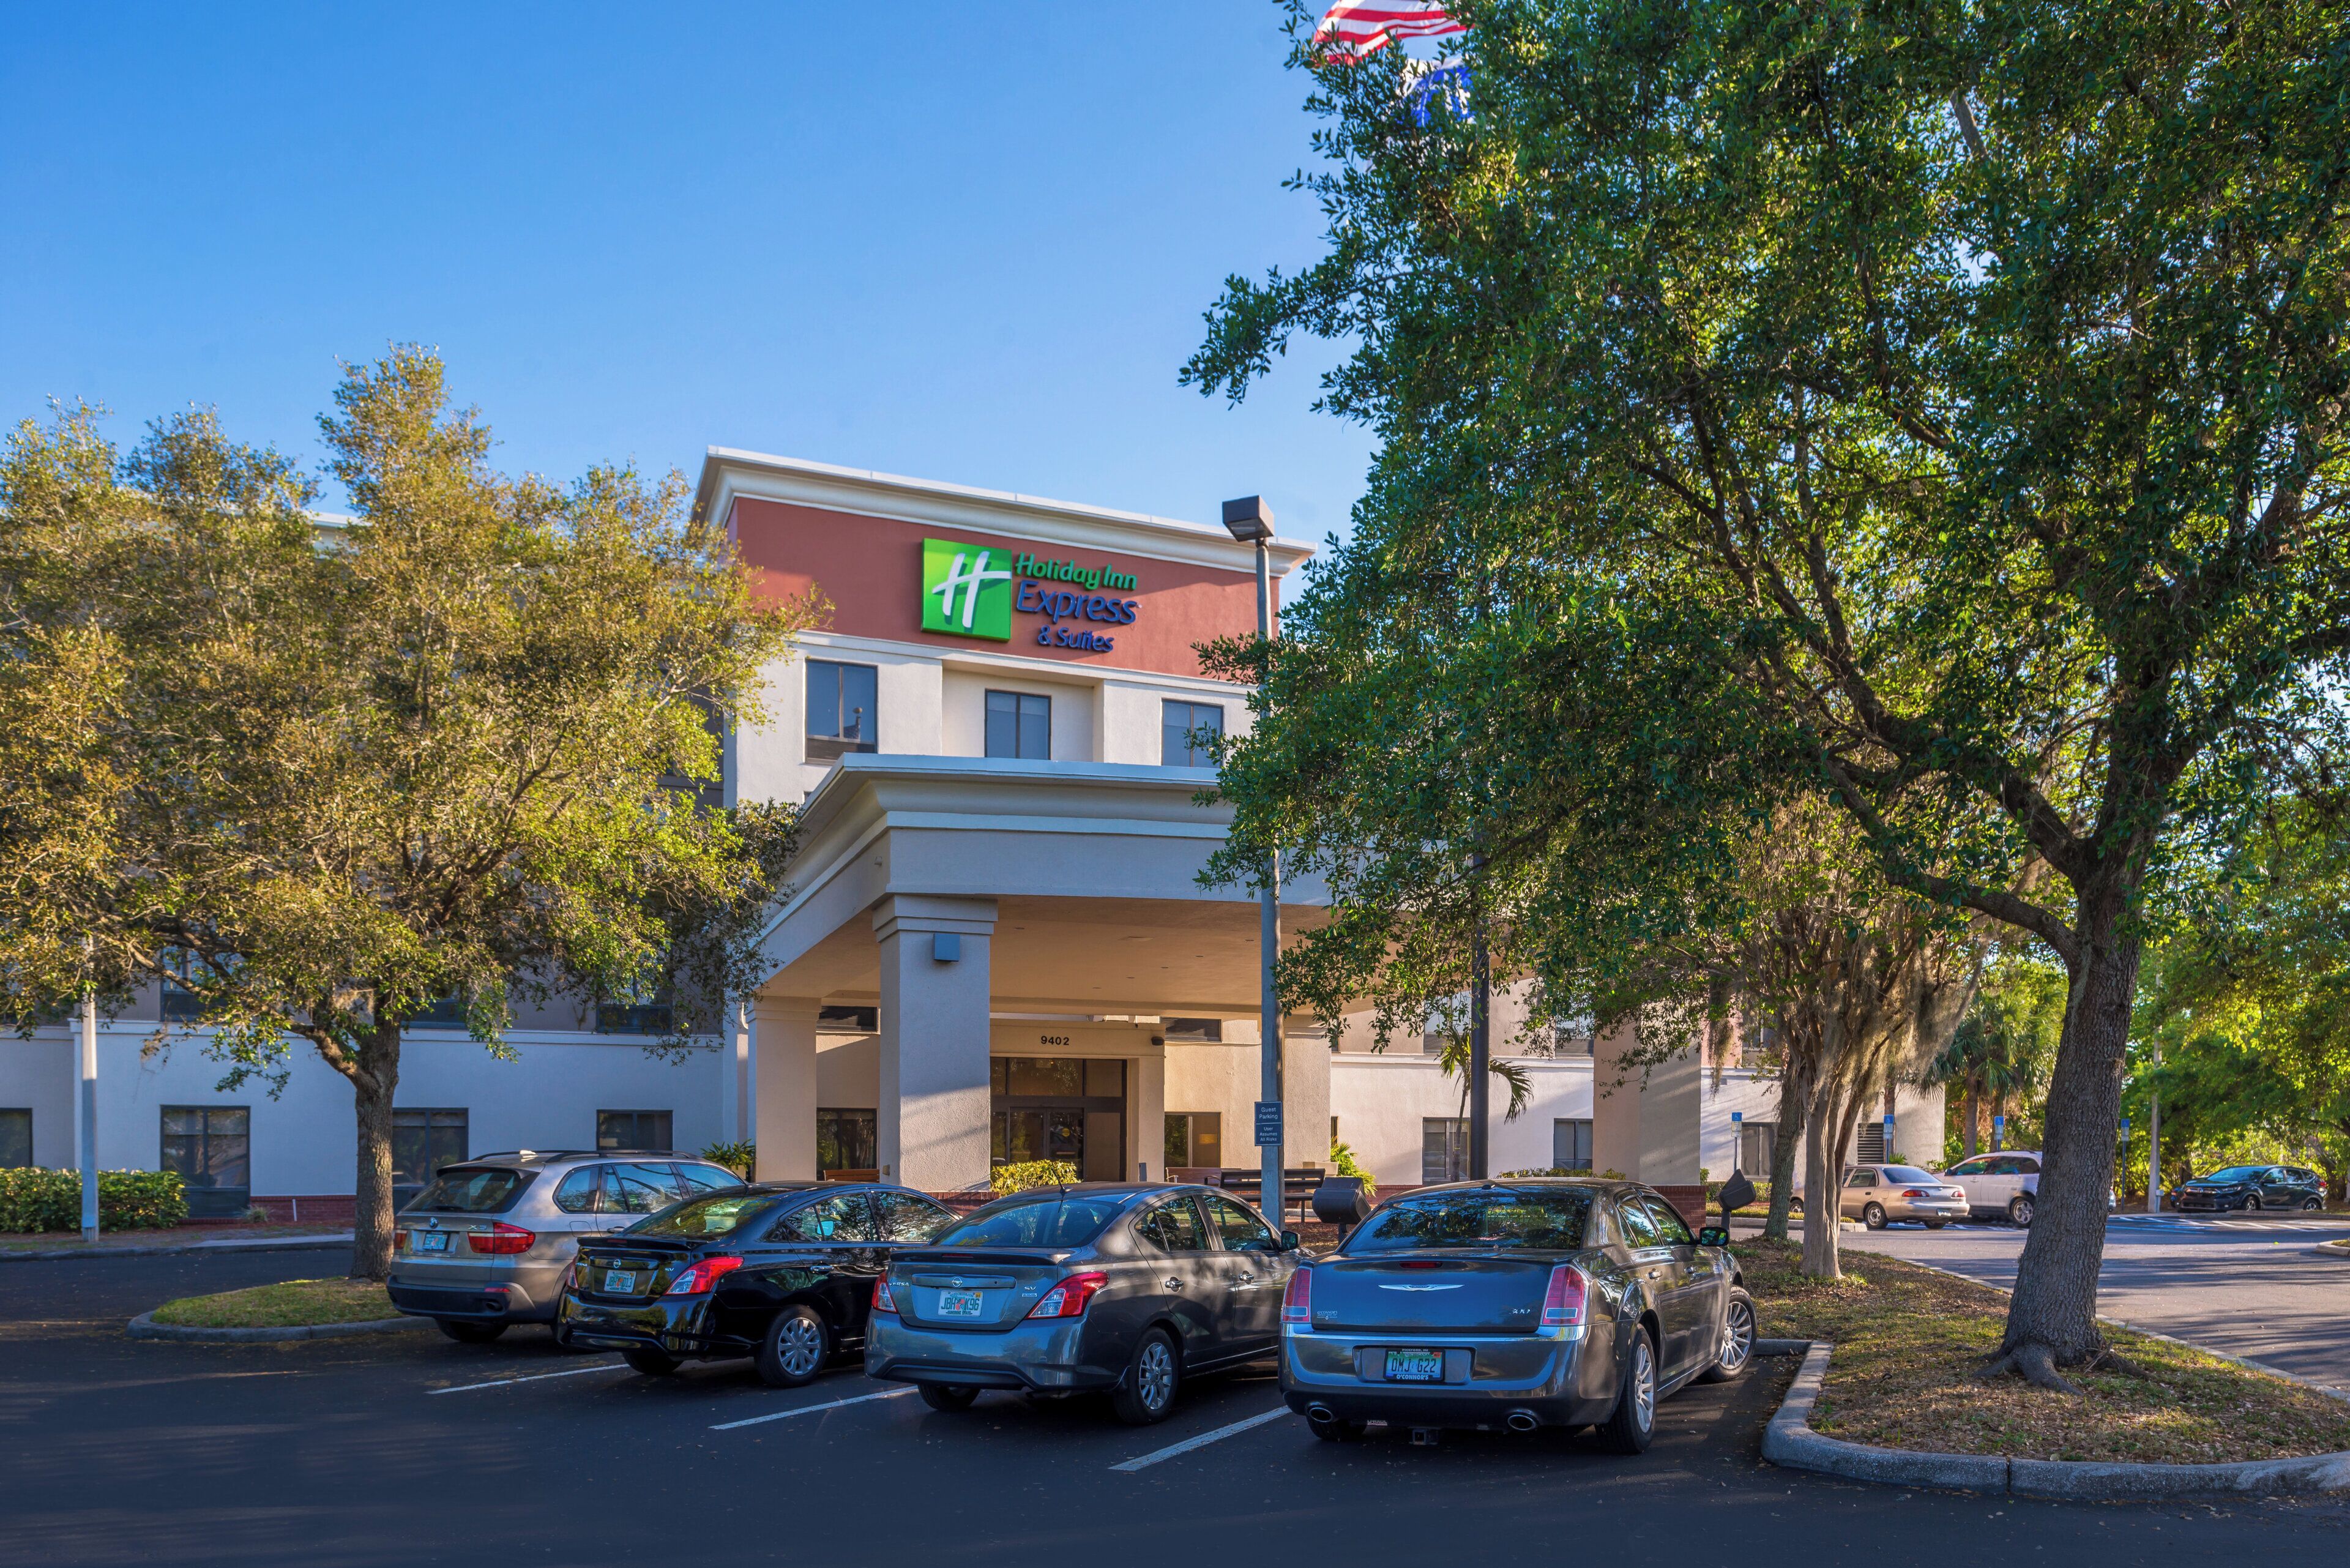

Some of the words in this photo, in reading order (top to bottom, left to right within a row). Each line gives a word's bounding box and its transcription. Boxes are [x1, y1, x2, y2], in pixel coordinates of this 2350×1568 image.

[1015, 552, 1100, 590] Holiday
[1102, 564, 1138, 591] Inn
[1016, 580, 1138, 624] Express
[1038, 625, 1052, 646] &
[1057, 626, 1114, 652] Suites
[1040, 1036, 1070, 1046] 9402
[941, 1297, 957, 1310] JBH
[964, 1298, 980, 1310] K96
